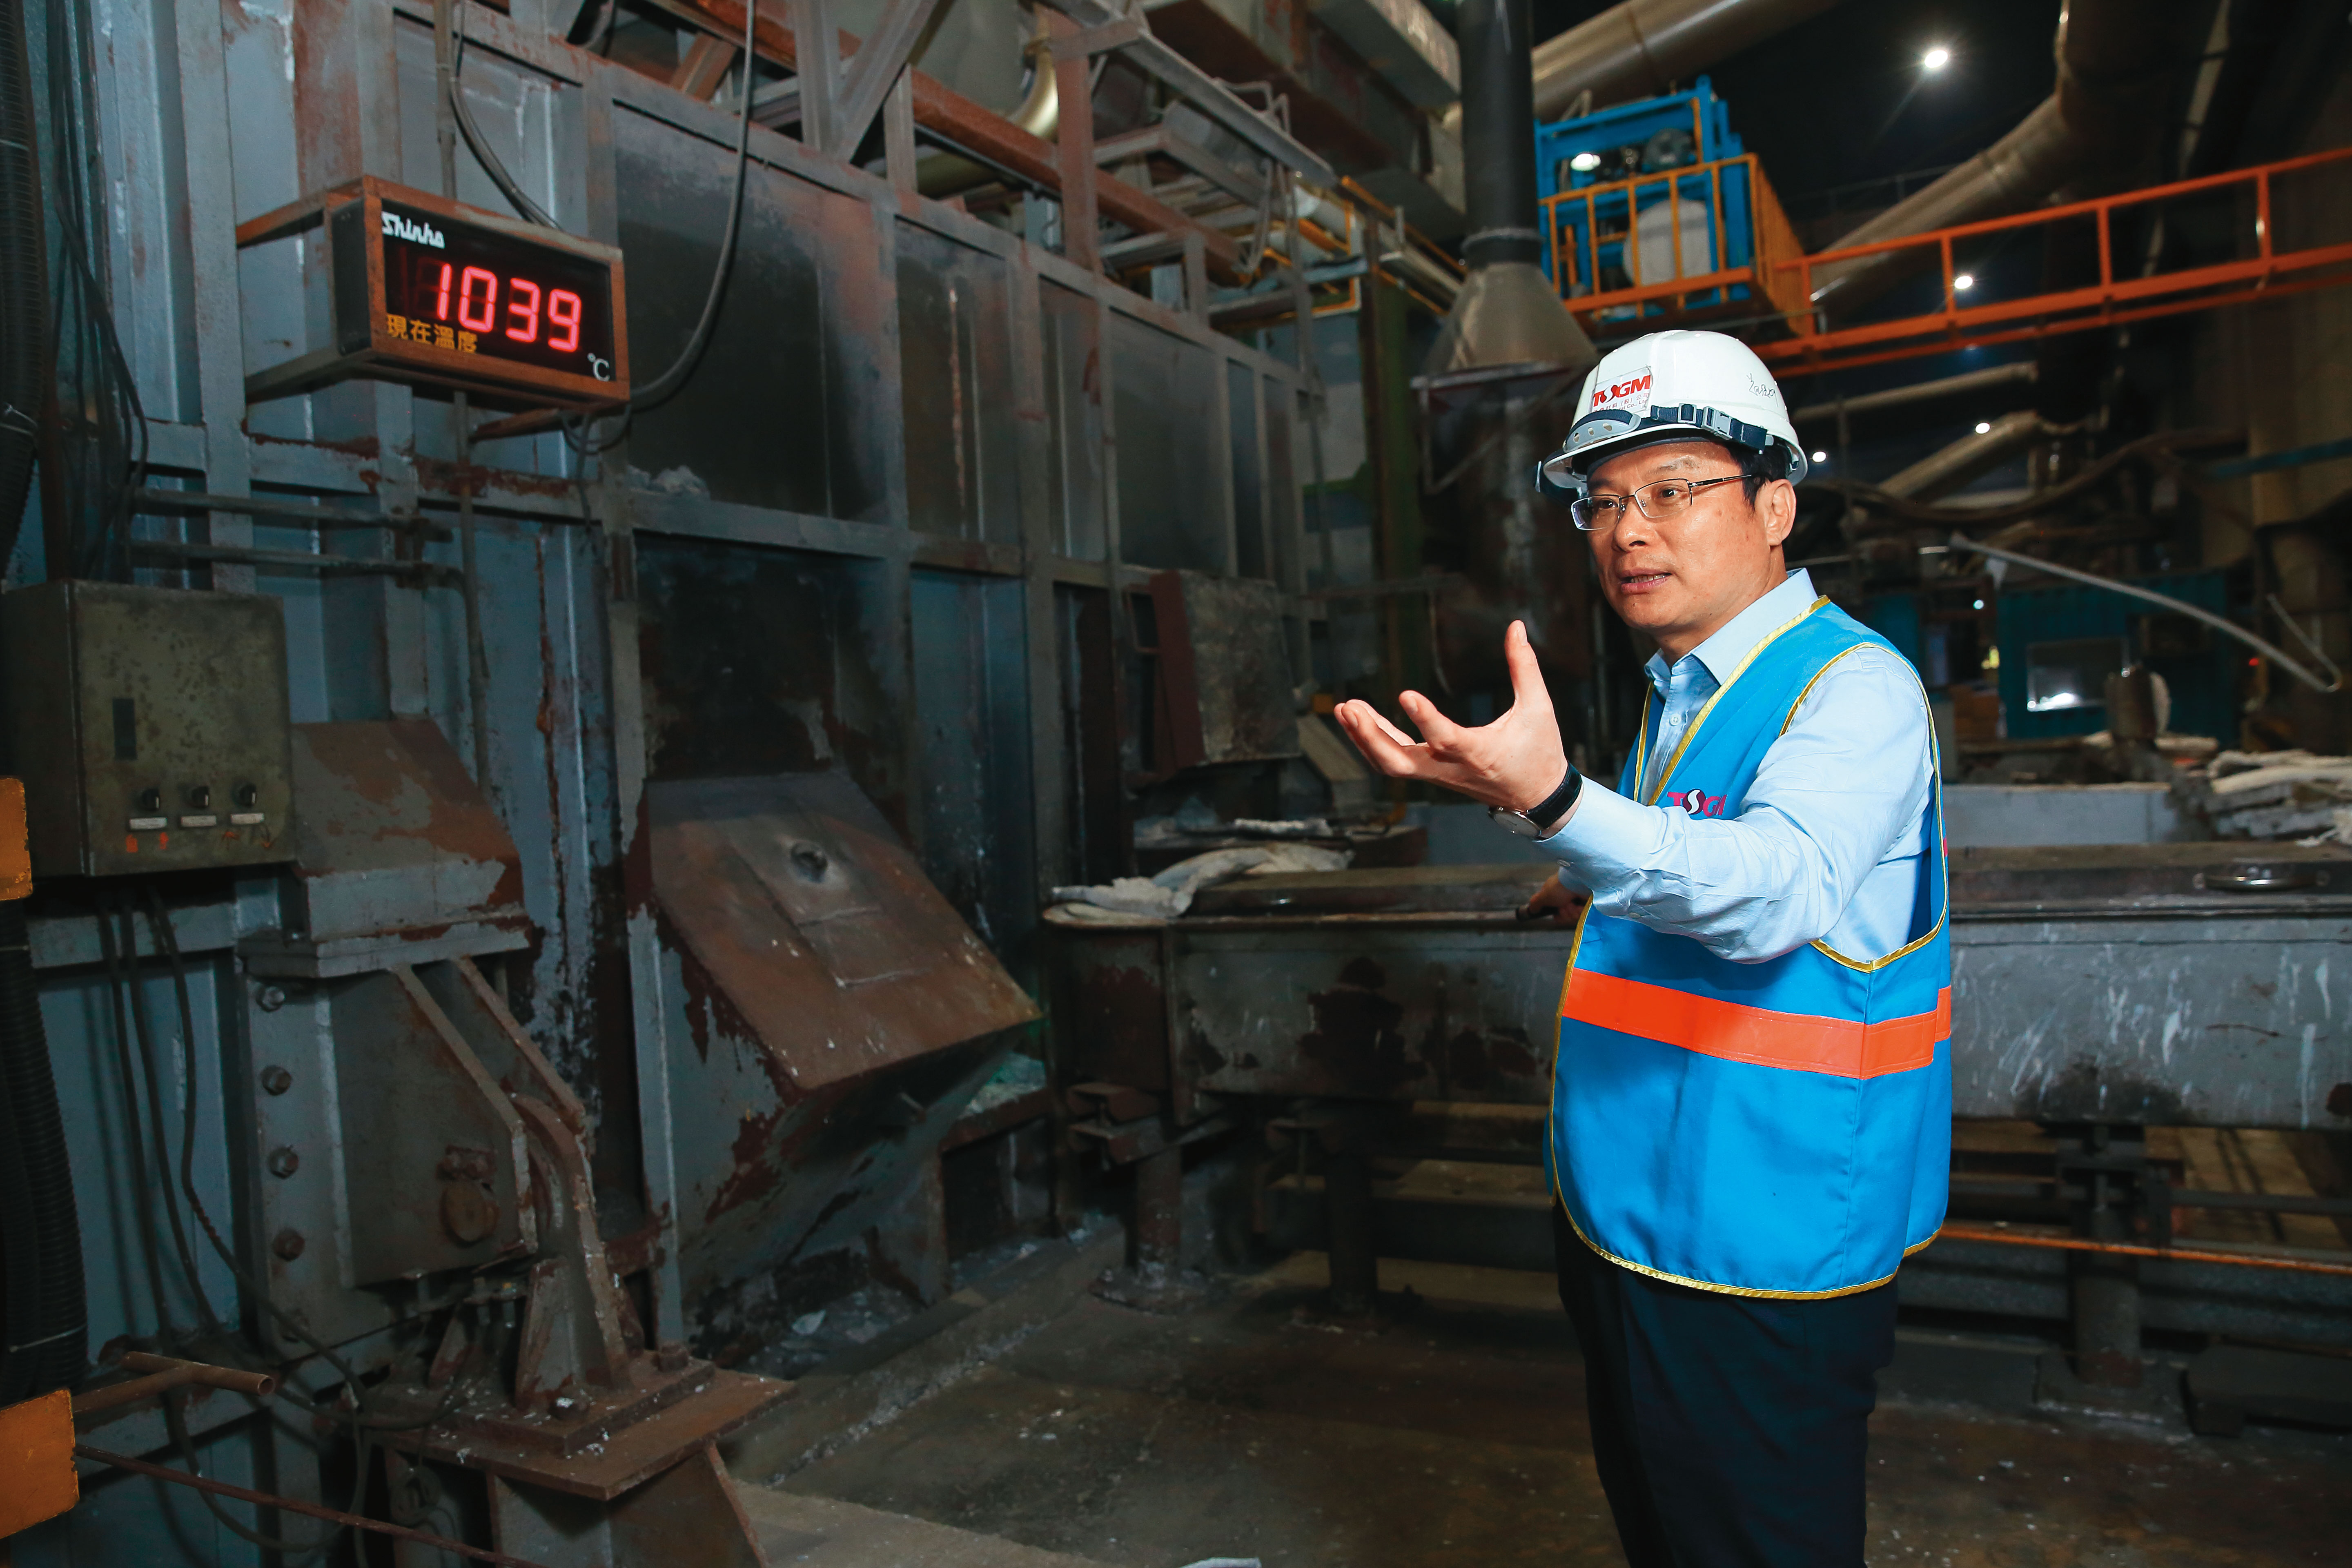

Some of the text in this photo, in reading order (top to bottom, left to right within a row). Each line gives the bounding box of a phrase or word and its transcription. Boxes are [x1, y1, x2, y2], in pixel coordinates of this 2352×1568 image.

[387, 314, 477, 354] 現在溫度
[437, 263, 581, 352] 1039
